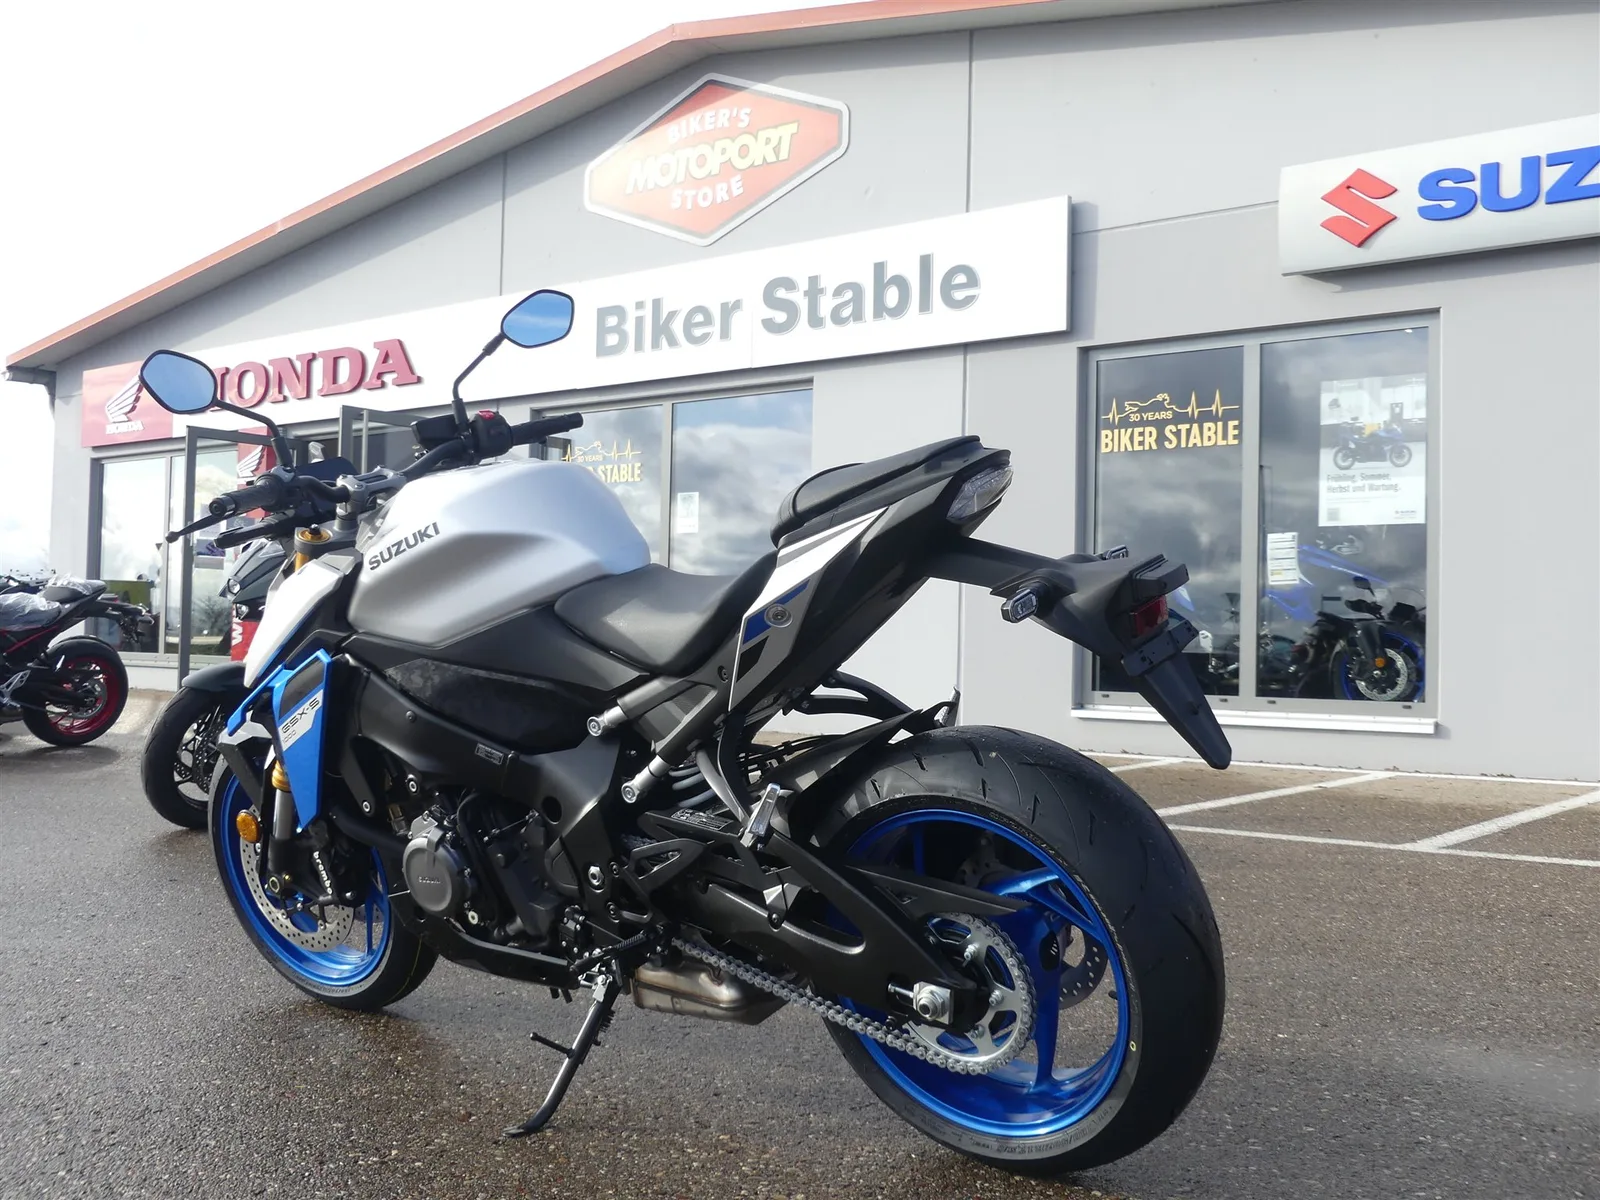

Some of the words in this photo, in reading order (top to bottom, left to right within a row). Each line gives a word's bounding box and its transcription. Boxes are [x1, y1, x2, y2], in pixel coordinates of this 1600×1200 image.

[666, 107, 752, 144] BIKER'S
[625, 121, 799, 195] MOTOPORT
[671, 174, 744, 210] STORE
[1417, 145, 1600, 221] SUZ
[596, 297, 743, 358] Biker
[760, 252, 981, 336] Stable
[1129, 413, 1140, 422] 30
[1142, 411, 1173, 421] YEARS
[1101, 426, 1158, 453] BIKER
[1164, 421, 1239, 449] STABLE
[598, 463, 641, 483] STABLE
[368, 522, 440, 571] SUZUKI
[282, 697, 320, 733] GSX-S
[313, 851, 333, 895] brembo
